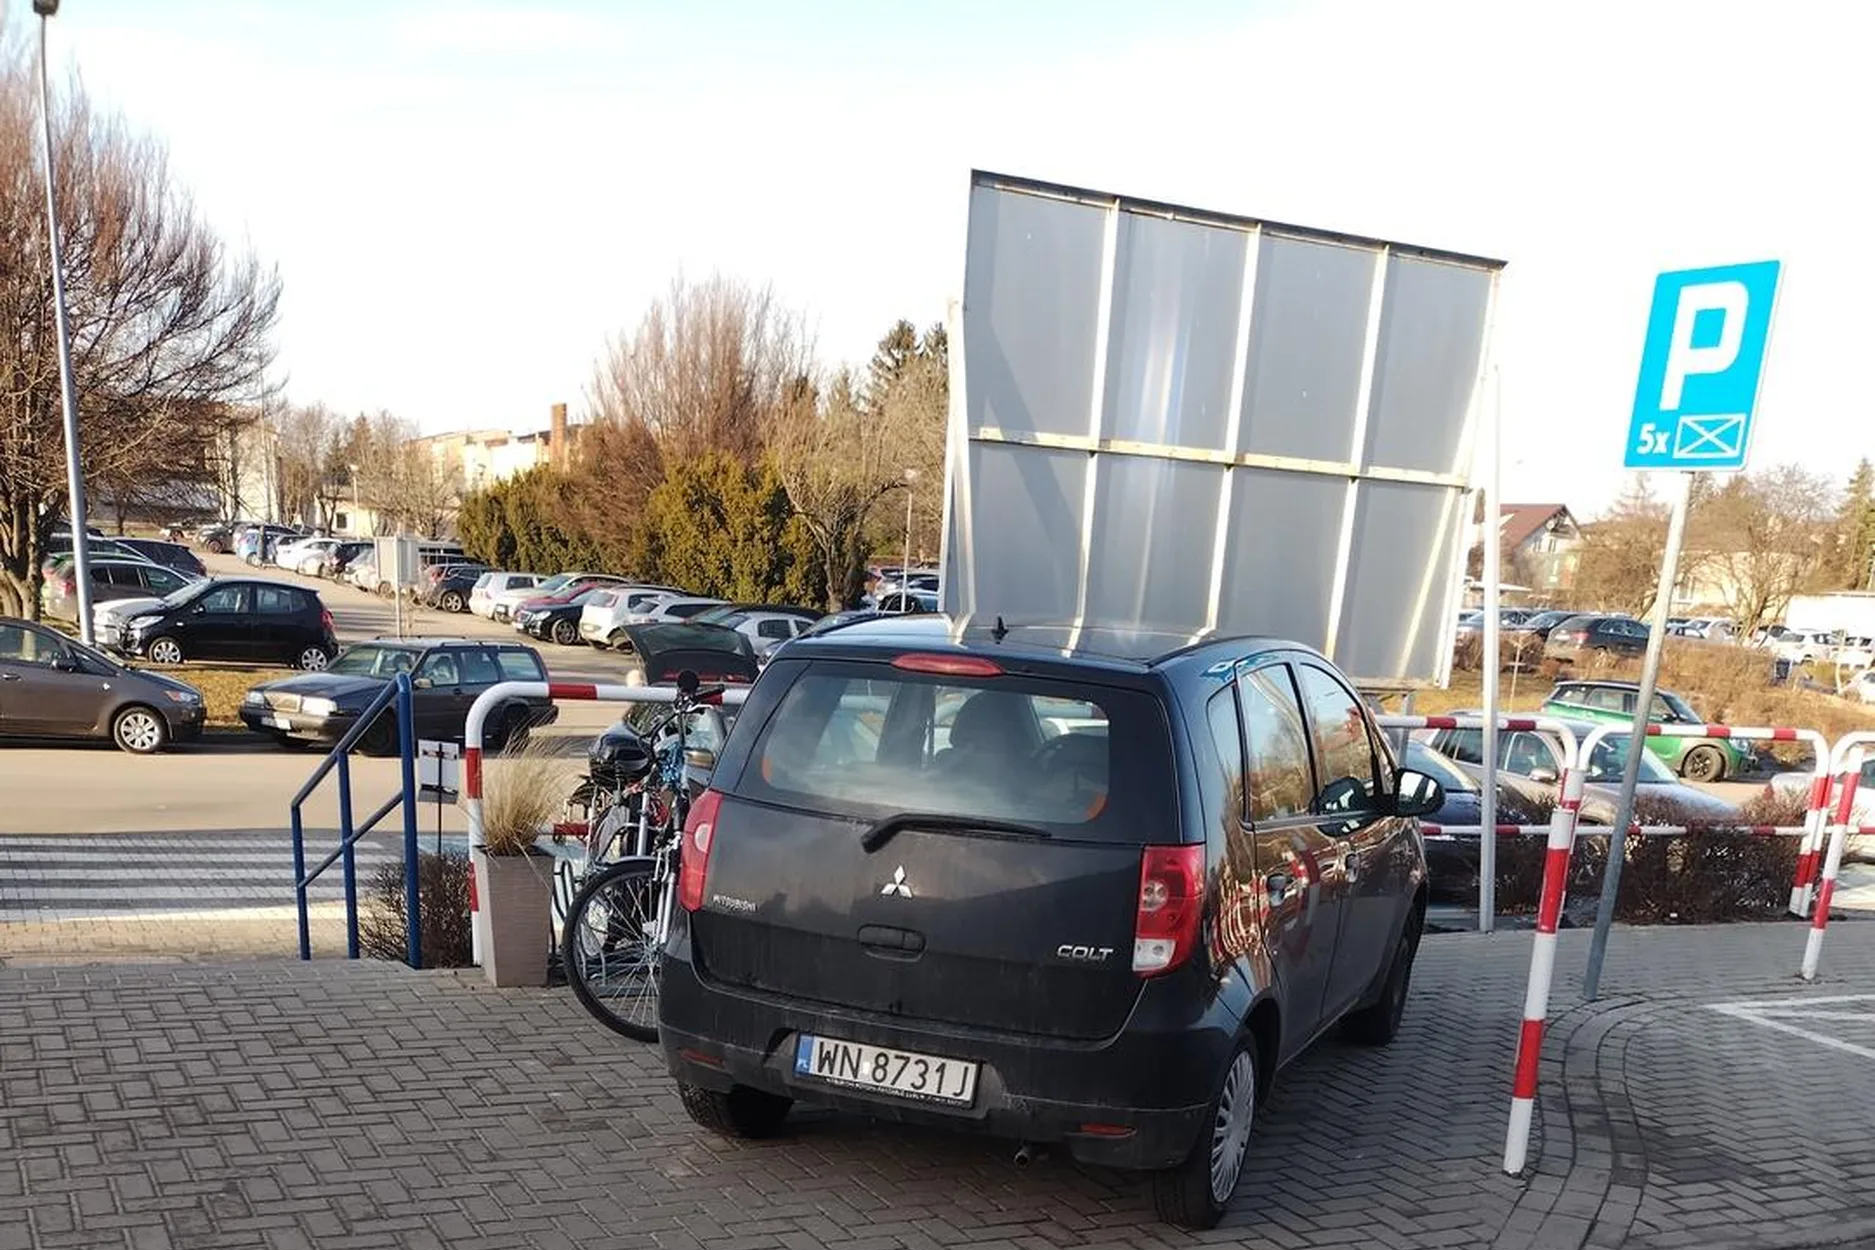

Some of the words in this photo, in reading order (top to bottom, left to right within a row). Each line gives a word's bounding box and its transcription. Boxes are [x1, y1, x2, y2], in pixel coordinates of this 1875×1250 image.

[1659, 280, 1749, 411] P
[1636, 422, 1670, 455] 5x
[1057, 944, 1114, 961] COLT
[817, 1041, 862, 1079] WN
[871, 1052, 969, 1098] 8731J
